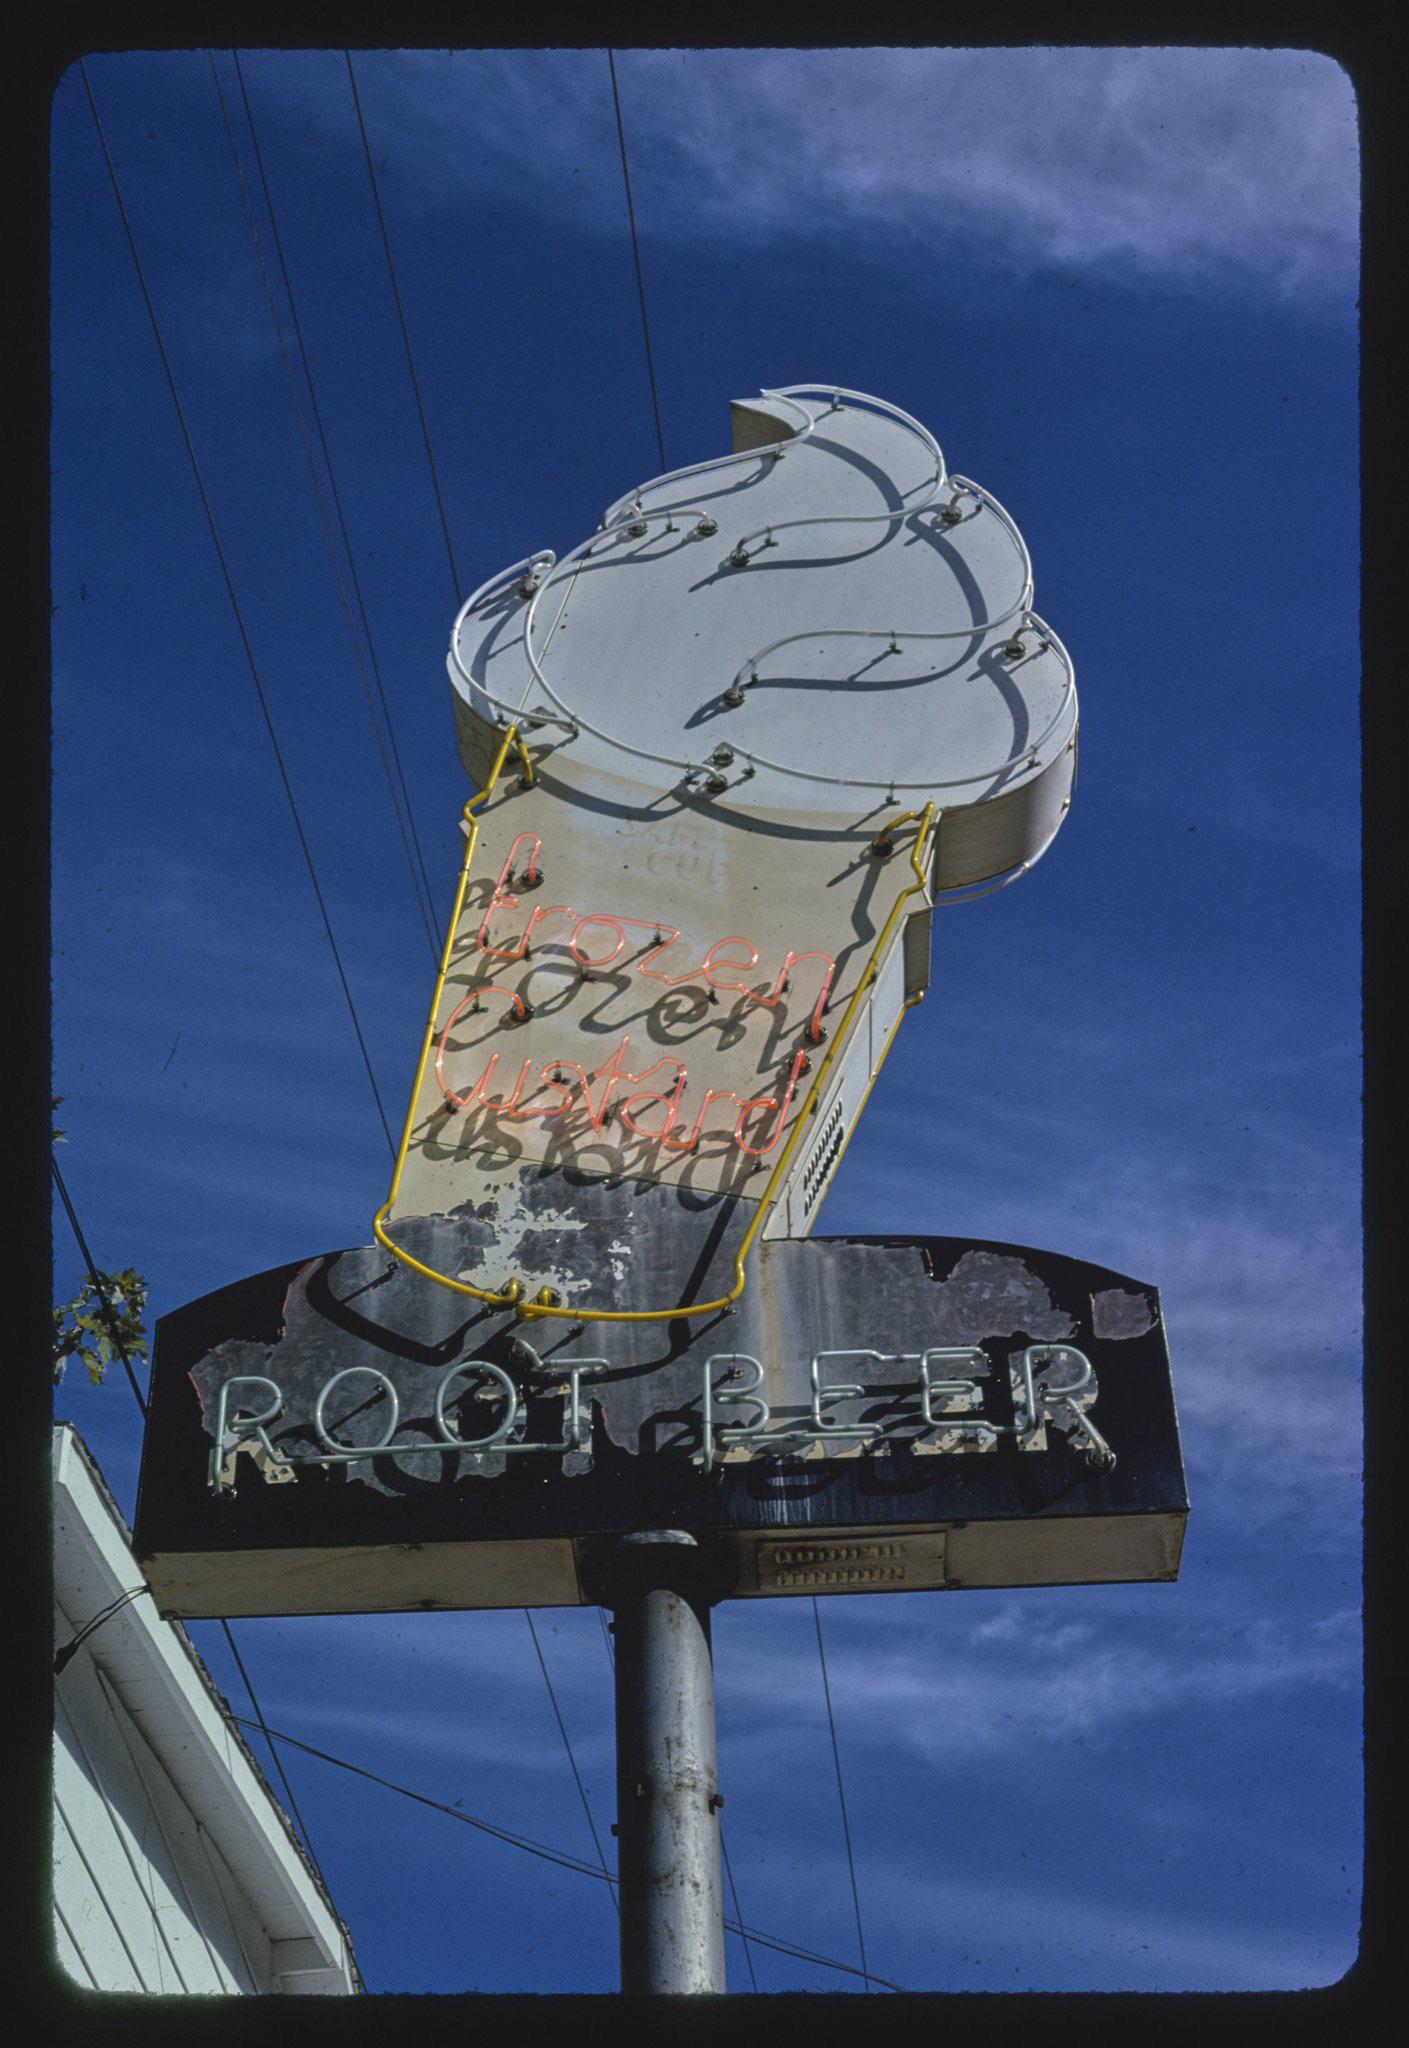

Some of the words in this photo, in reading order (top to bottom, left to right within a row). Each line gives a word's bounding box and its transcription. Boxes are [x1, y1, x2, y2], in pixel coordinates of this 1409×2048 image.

[435, 986, 806, 1155] Custard
[213, 1342, 611, 1495] ROOT
[703, 1344, 1114, 1475] BEER
